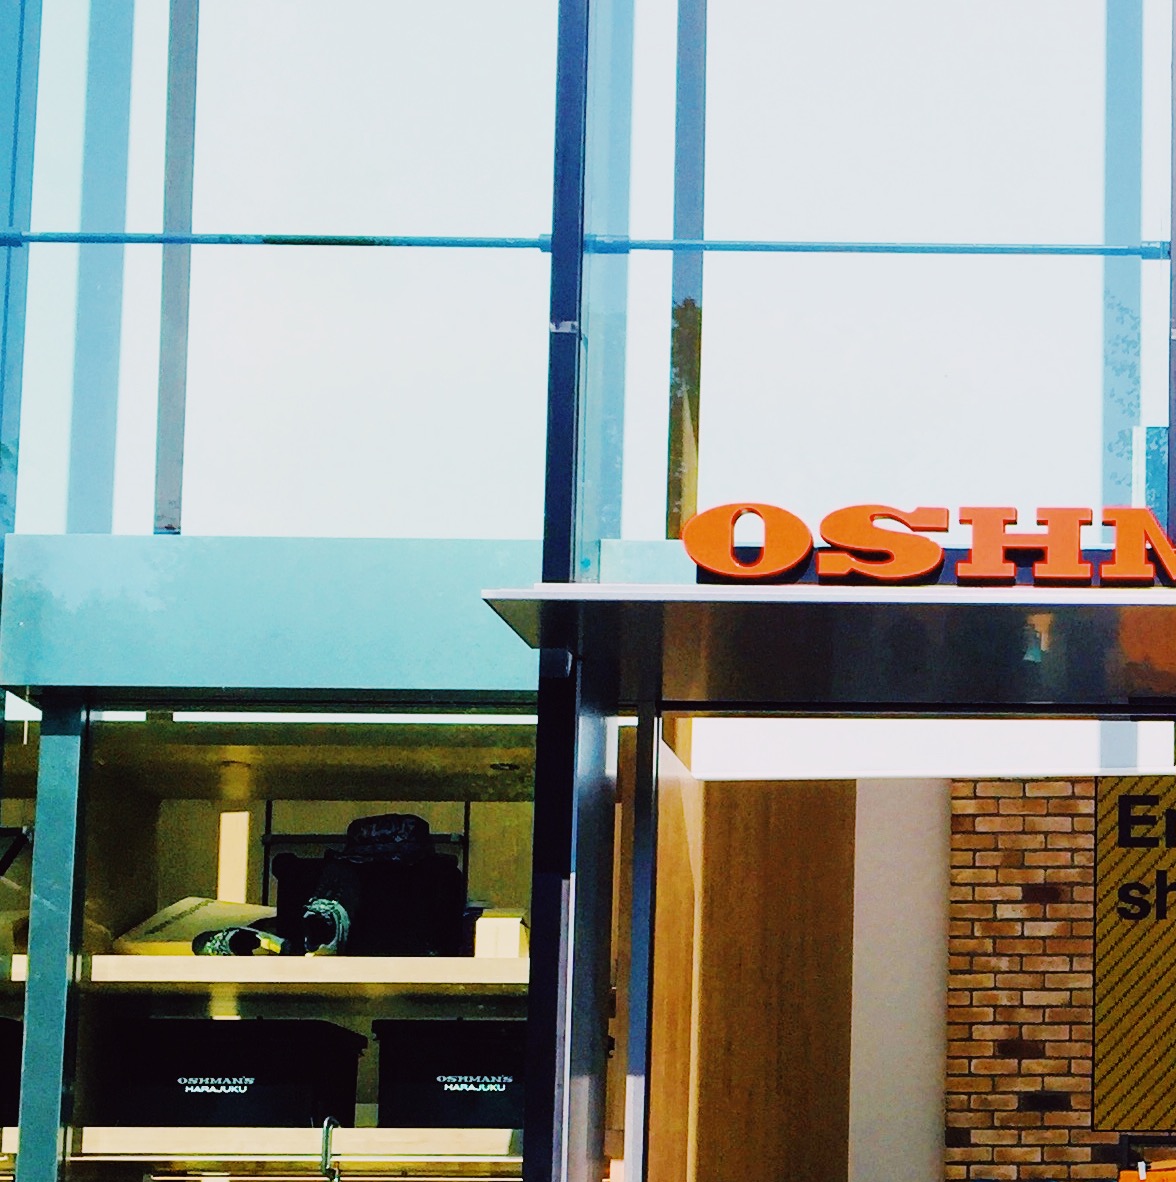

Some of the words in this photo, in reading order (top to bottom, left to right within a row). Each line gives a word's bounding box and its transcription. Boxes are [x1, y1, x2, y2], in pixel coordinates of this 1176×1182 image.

[177, 1075, 256, 1085] OSHMAN'S
[436, 1074, 514, 1083] OSHMAN'S
[444, 1083, 506, 1091] HARAJUKU
